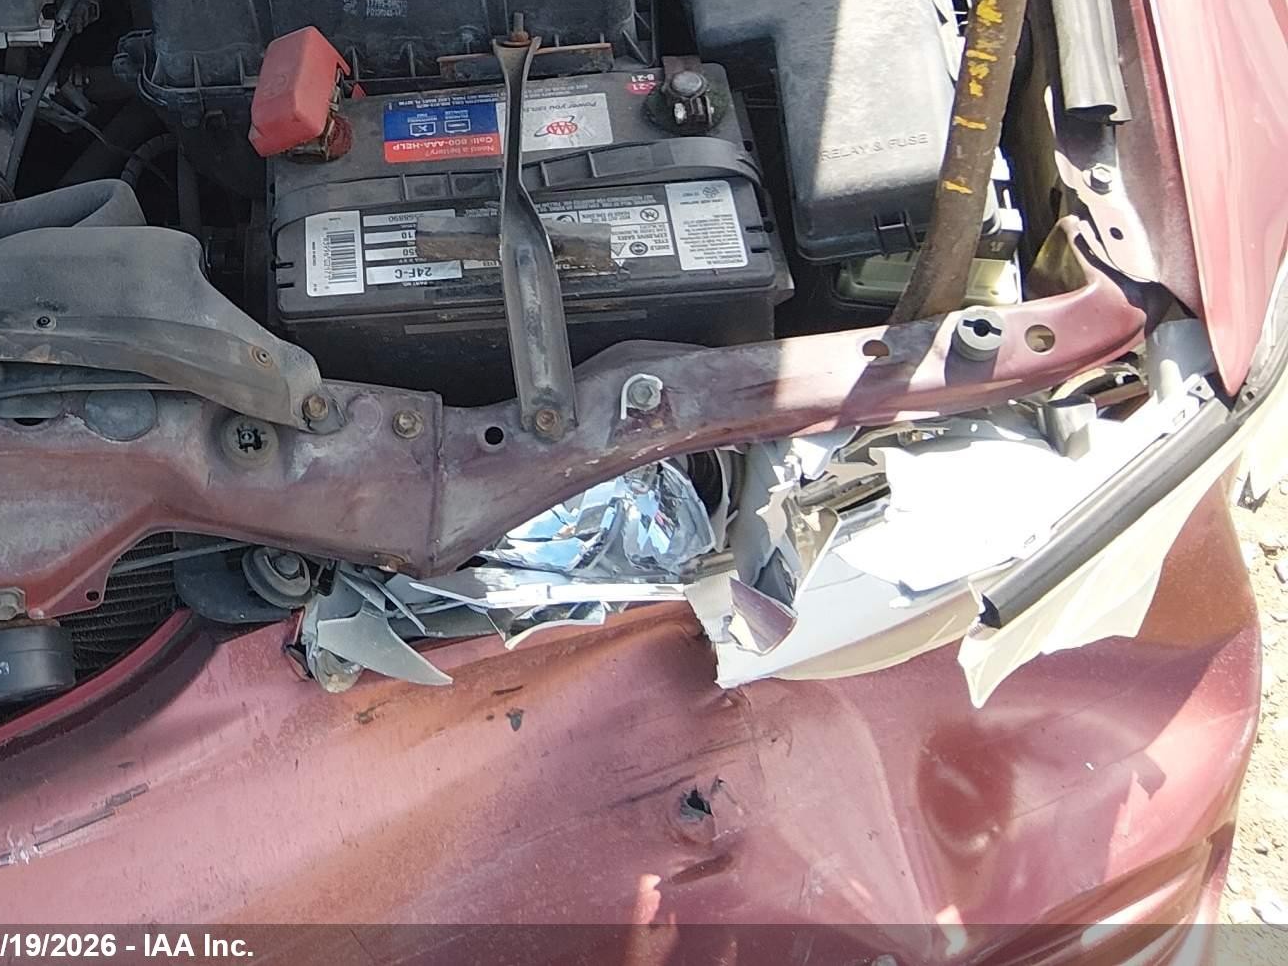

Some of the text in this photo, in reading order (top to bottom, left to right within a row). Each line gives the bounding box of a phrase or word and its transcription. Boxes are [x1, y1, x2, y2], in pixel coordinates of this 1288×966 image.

[820, 134, 929, 161] RELAY & FUSE
[402, 248, 417, 256] 50
[394, 266, 433, 279] 24F-C
